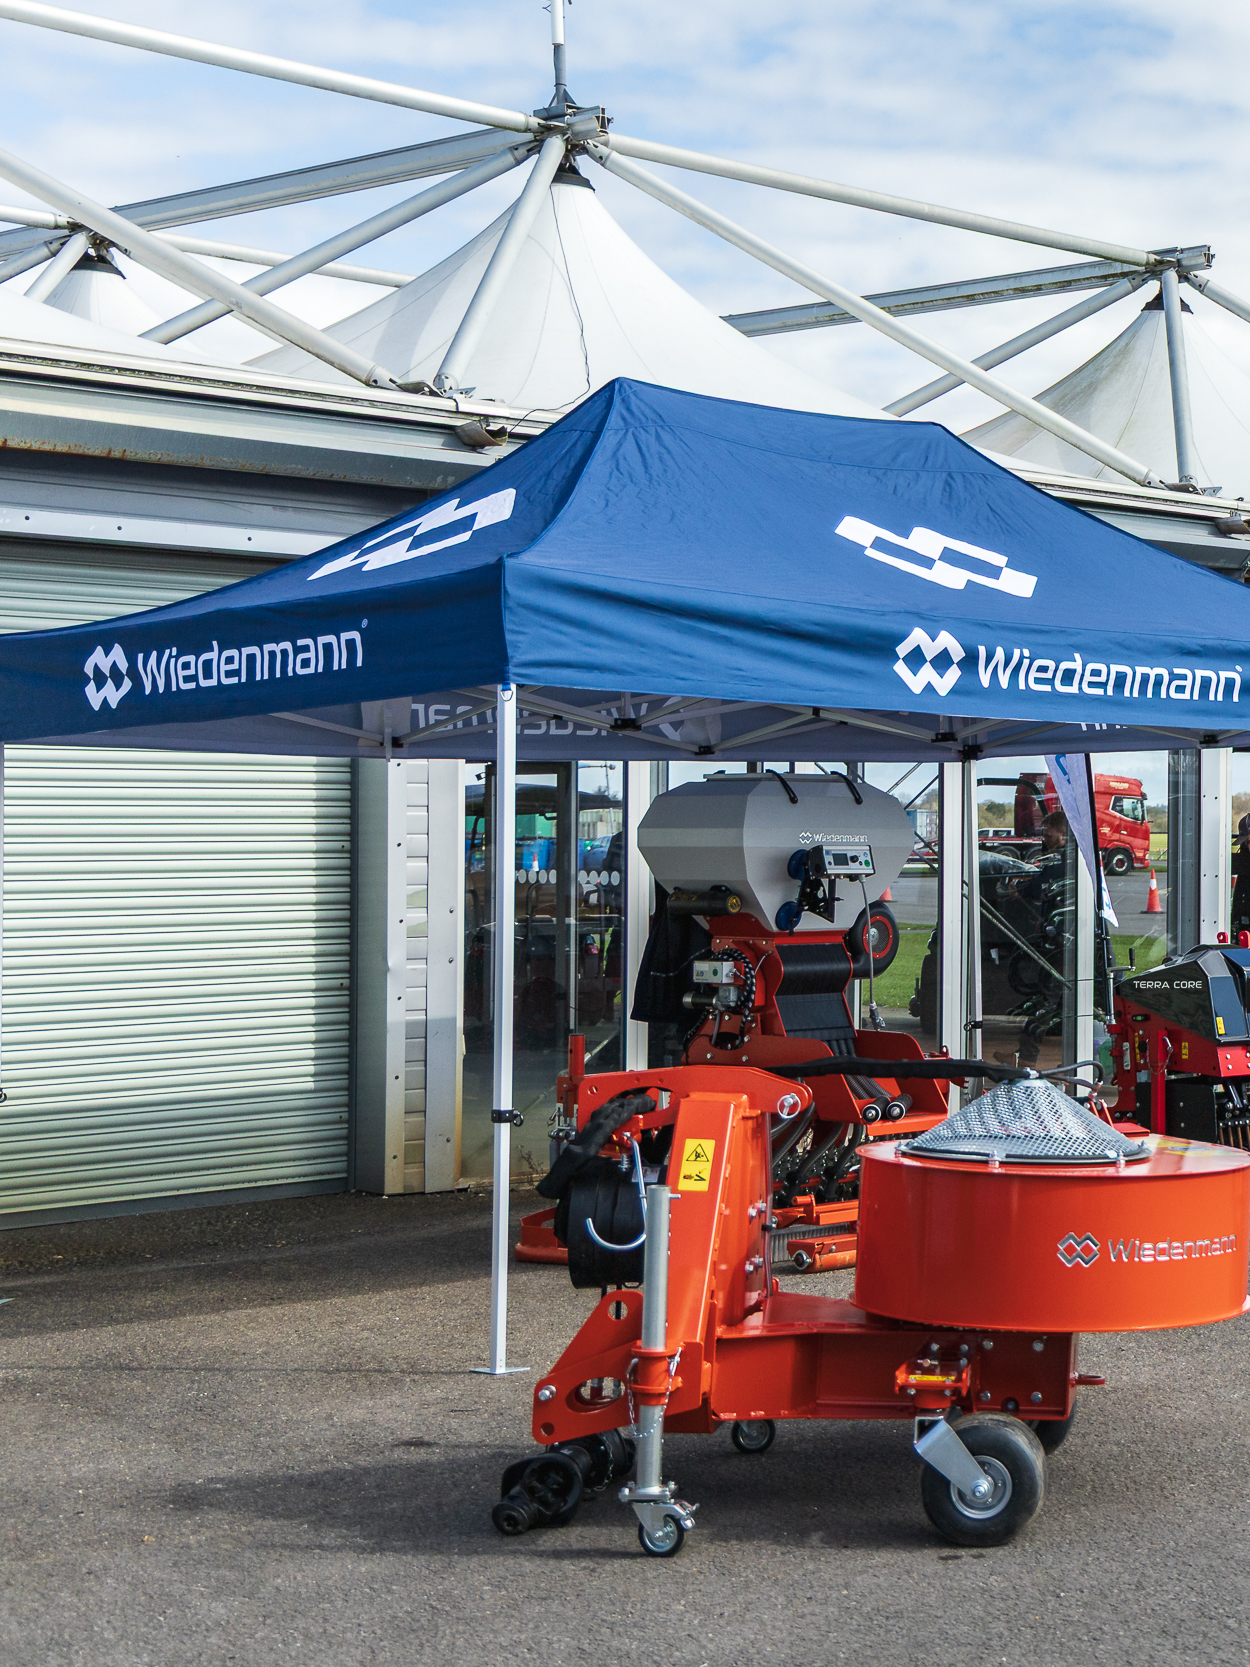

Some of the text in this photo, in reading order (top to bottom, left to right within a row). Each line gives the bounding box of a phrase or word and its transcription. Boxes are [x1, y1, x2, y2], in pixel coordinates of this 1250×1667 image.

[137, 629, 364, 696] Wiedenmann
[976, 645, 1241, 703] Wiedenmann
[813, 832, 868, 843] Wiedenmann
[1133, 980, 1203, 989] TERRA CORE
[1107, 1234, 1237, 1263] Wiedenmann
